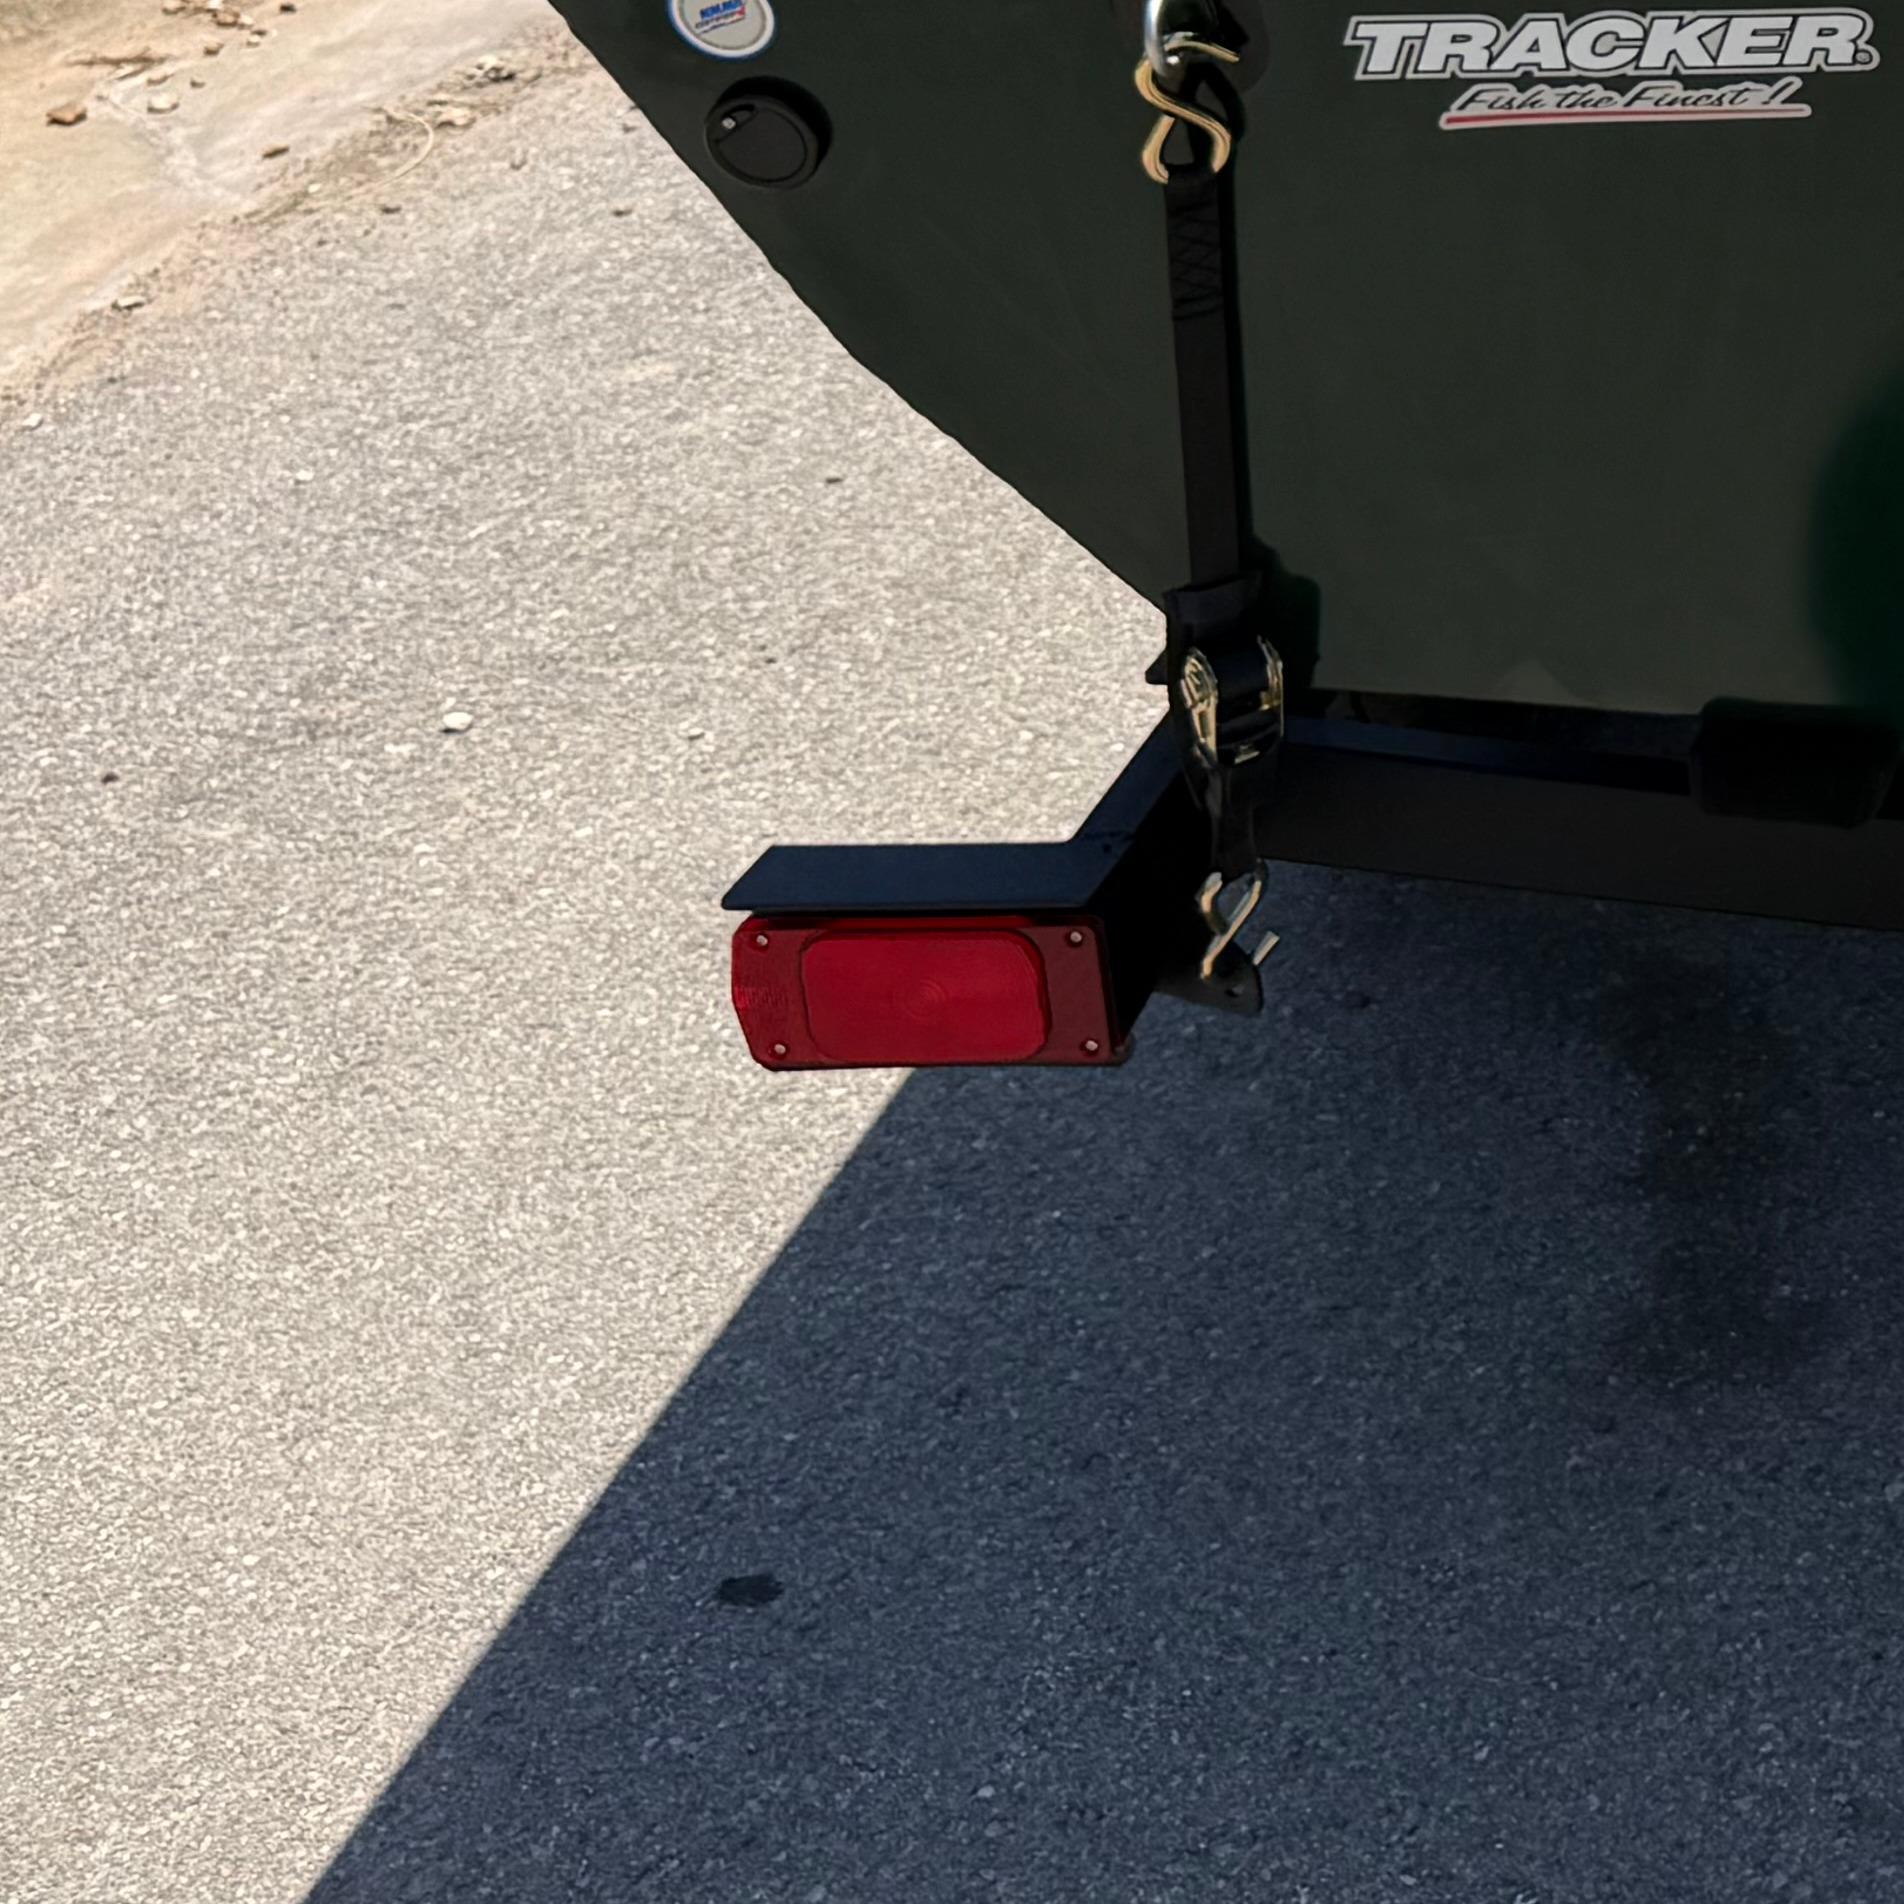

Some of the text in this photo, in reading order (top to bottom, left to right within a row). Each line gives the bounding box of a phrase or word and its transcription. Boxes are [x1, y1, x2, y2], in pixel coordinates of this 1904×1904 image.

[1350, 11, 1874, 76] TRACKER
[1457, 82, 1546, 114] Fish
[1551, 84, 1618, 110] the
